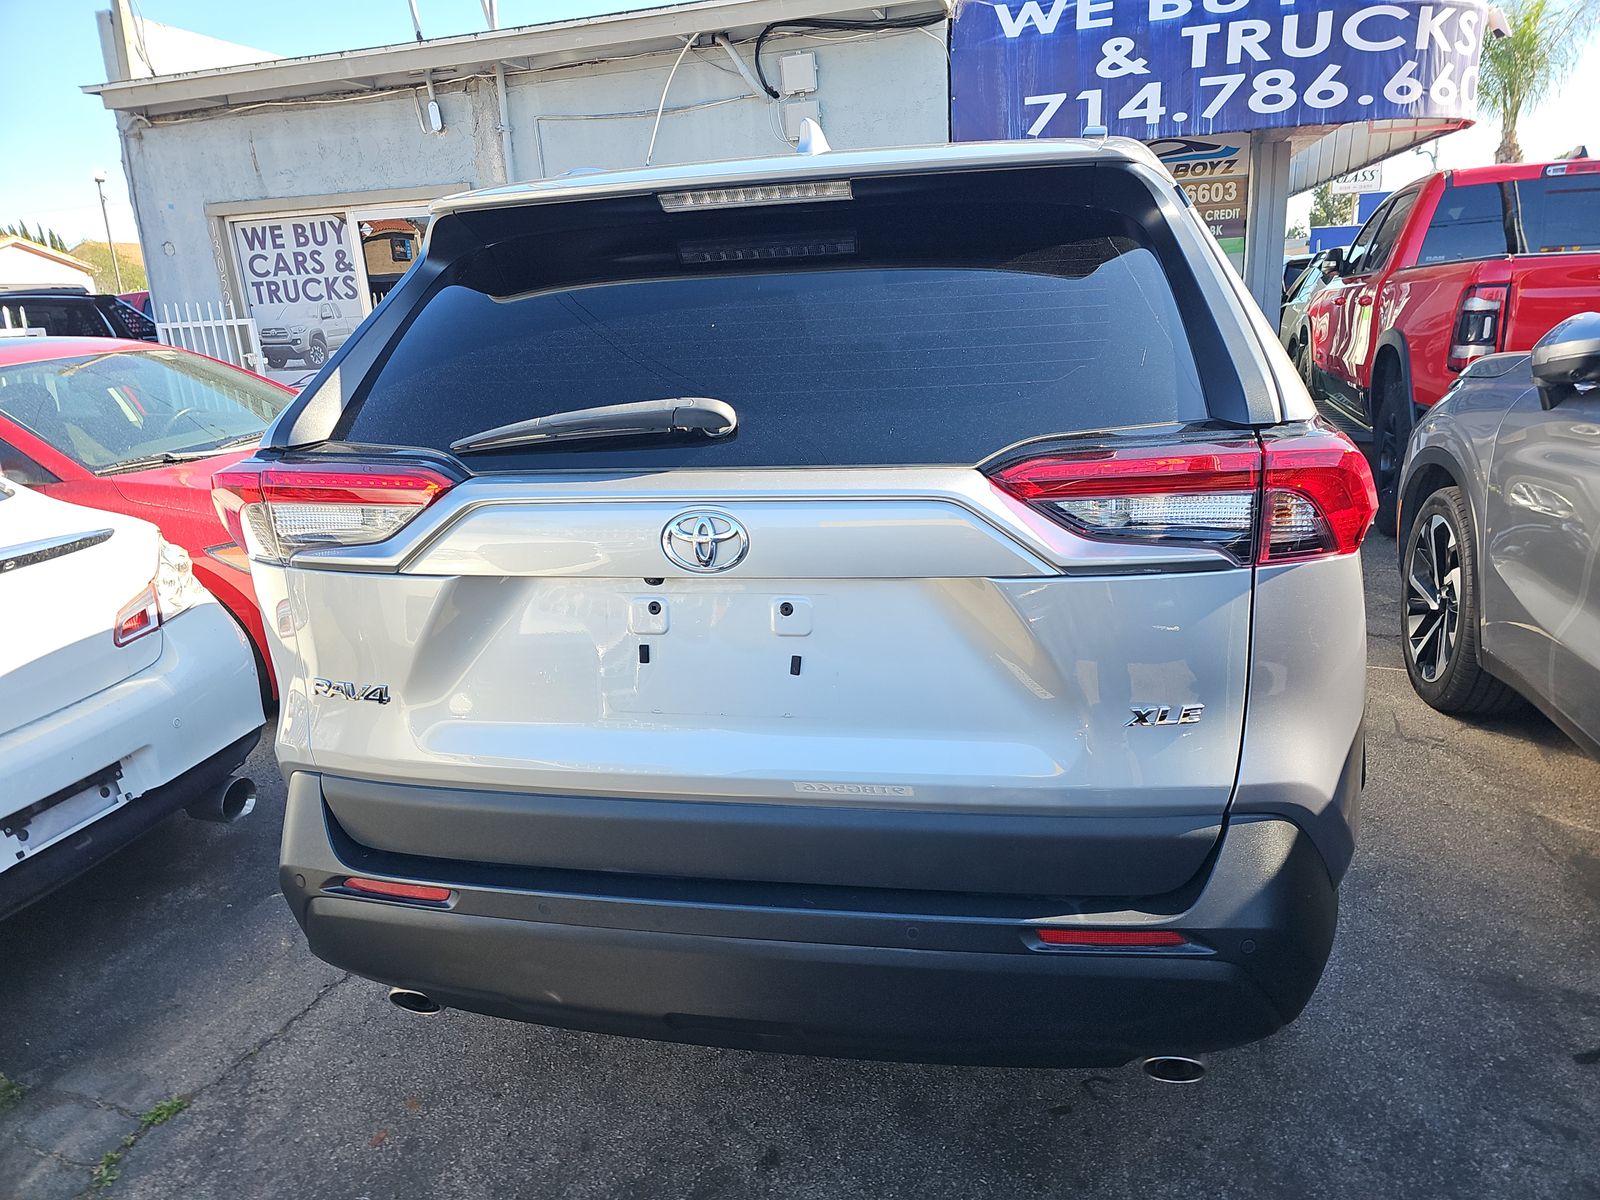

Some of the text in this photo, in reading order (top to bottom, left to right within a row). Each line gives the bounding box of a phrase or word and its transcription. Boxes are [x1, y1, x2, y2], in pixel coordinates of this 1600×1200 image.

[994, 0, 1114, 39] WE
[1095, 5, 1479, 79] & TRUCKS
[1172, 159, 1239, 178] BOYZ
[1205, 207, 1241, 221] CREDIT
[240, 220, 345, 251] WE BUY
[211, 221, 233, 307] 13052
[248, 249, 355, 278] CARS &
[251, 275, 358, 305] TRUCKS
[313, 677, 391, 705] RAV4
[1123, 703, 1205, 727] XLE
